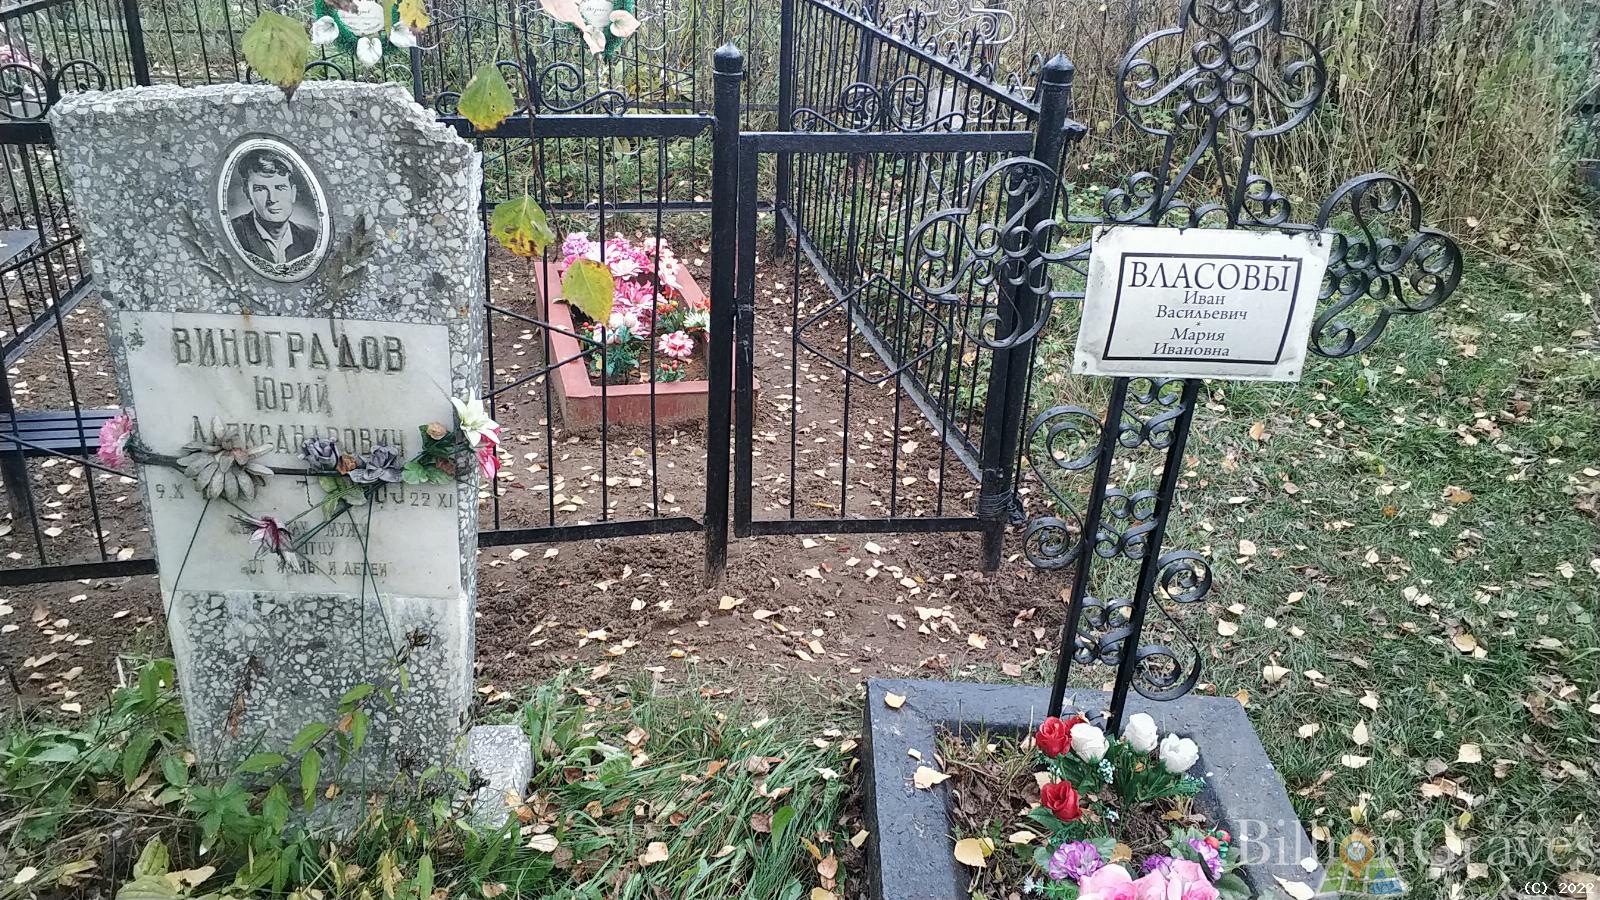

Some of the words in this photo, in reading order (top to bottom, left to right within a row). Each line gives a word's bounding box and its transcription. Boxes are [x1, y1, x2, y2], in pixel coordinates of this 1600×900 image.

[1128, 261, 1291, 292] ВЛАСОВЫ
[1183, 290, 1226, 305] Иван
[1155, 305, 1248, 321] Васильевич
[1170, 327, 1226, 343] Мария
[171, 327, 406, 374] ВИНОГРАДОВ
[1152, 343, 1230, 357] Ивановна
[253, 375, 333, 416] ЮРИЙ
[191, 416, 405, 458] АКСАНРОВИЧ
[410, 492, 430, 507] 22
